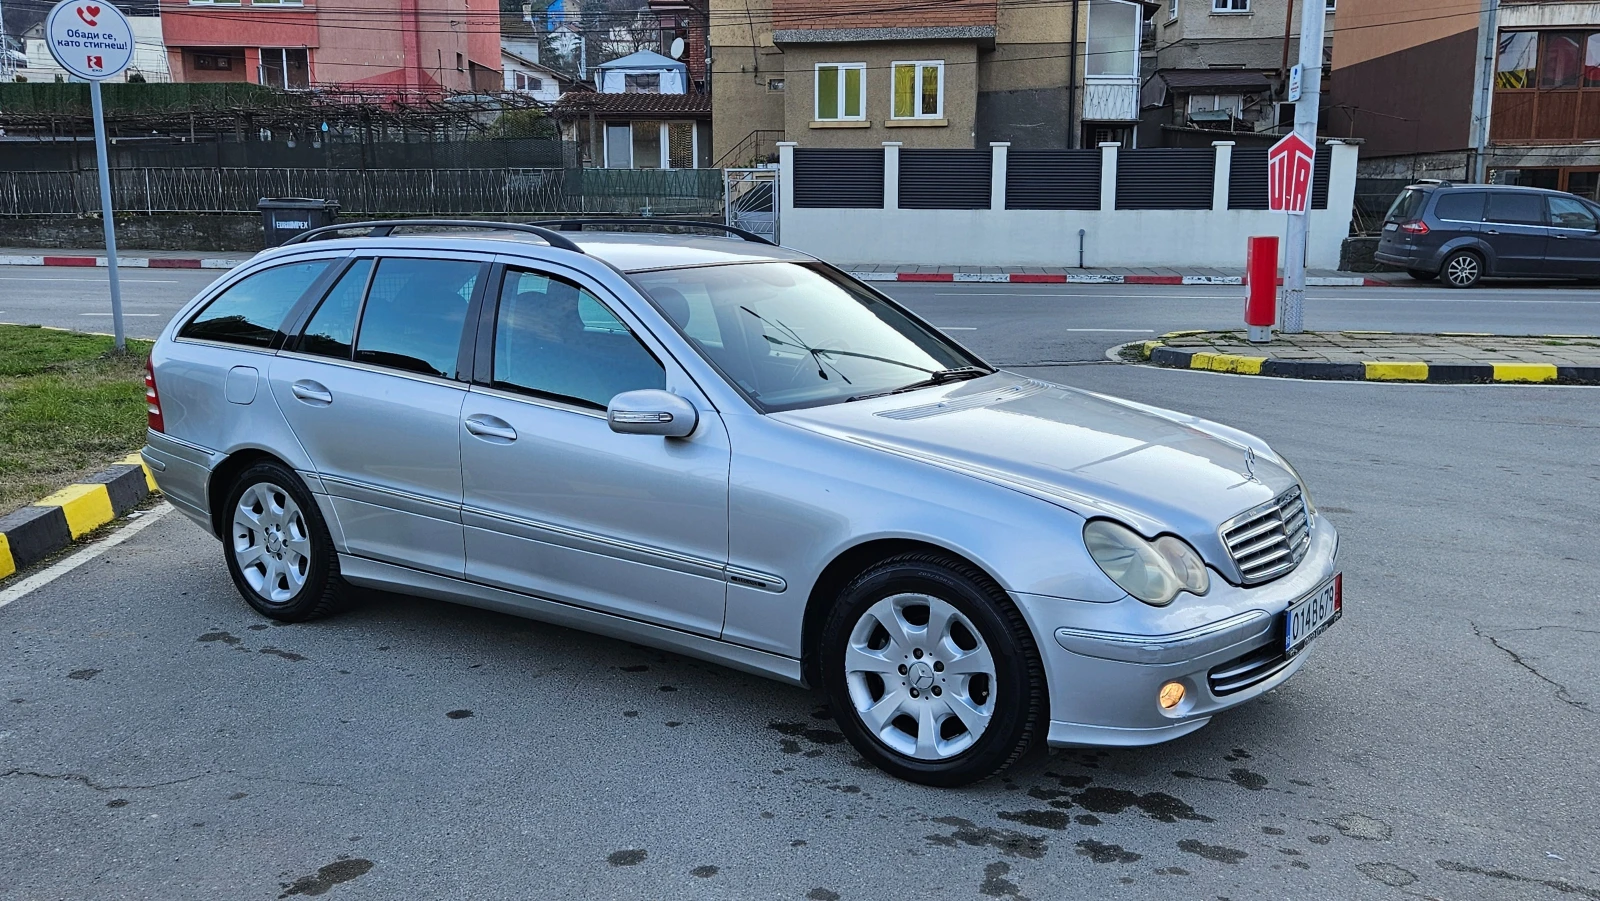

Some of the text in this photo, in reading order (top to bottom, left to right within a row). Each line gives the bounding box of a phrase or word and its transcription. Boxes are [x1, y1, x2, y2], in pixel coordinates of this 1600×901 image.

[67, 29, 117, 42] Обади се,
[57, 39, 128, 50] като стигнеш!
